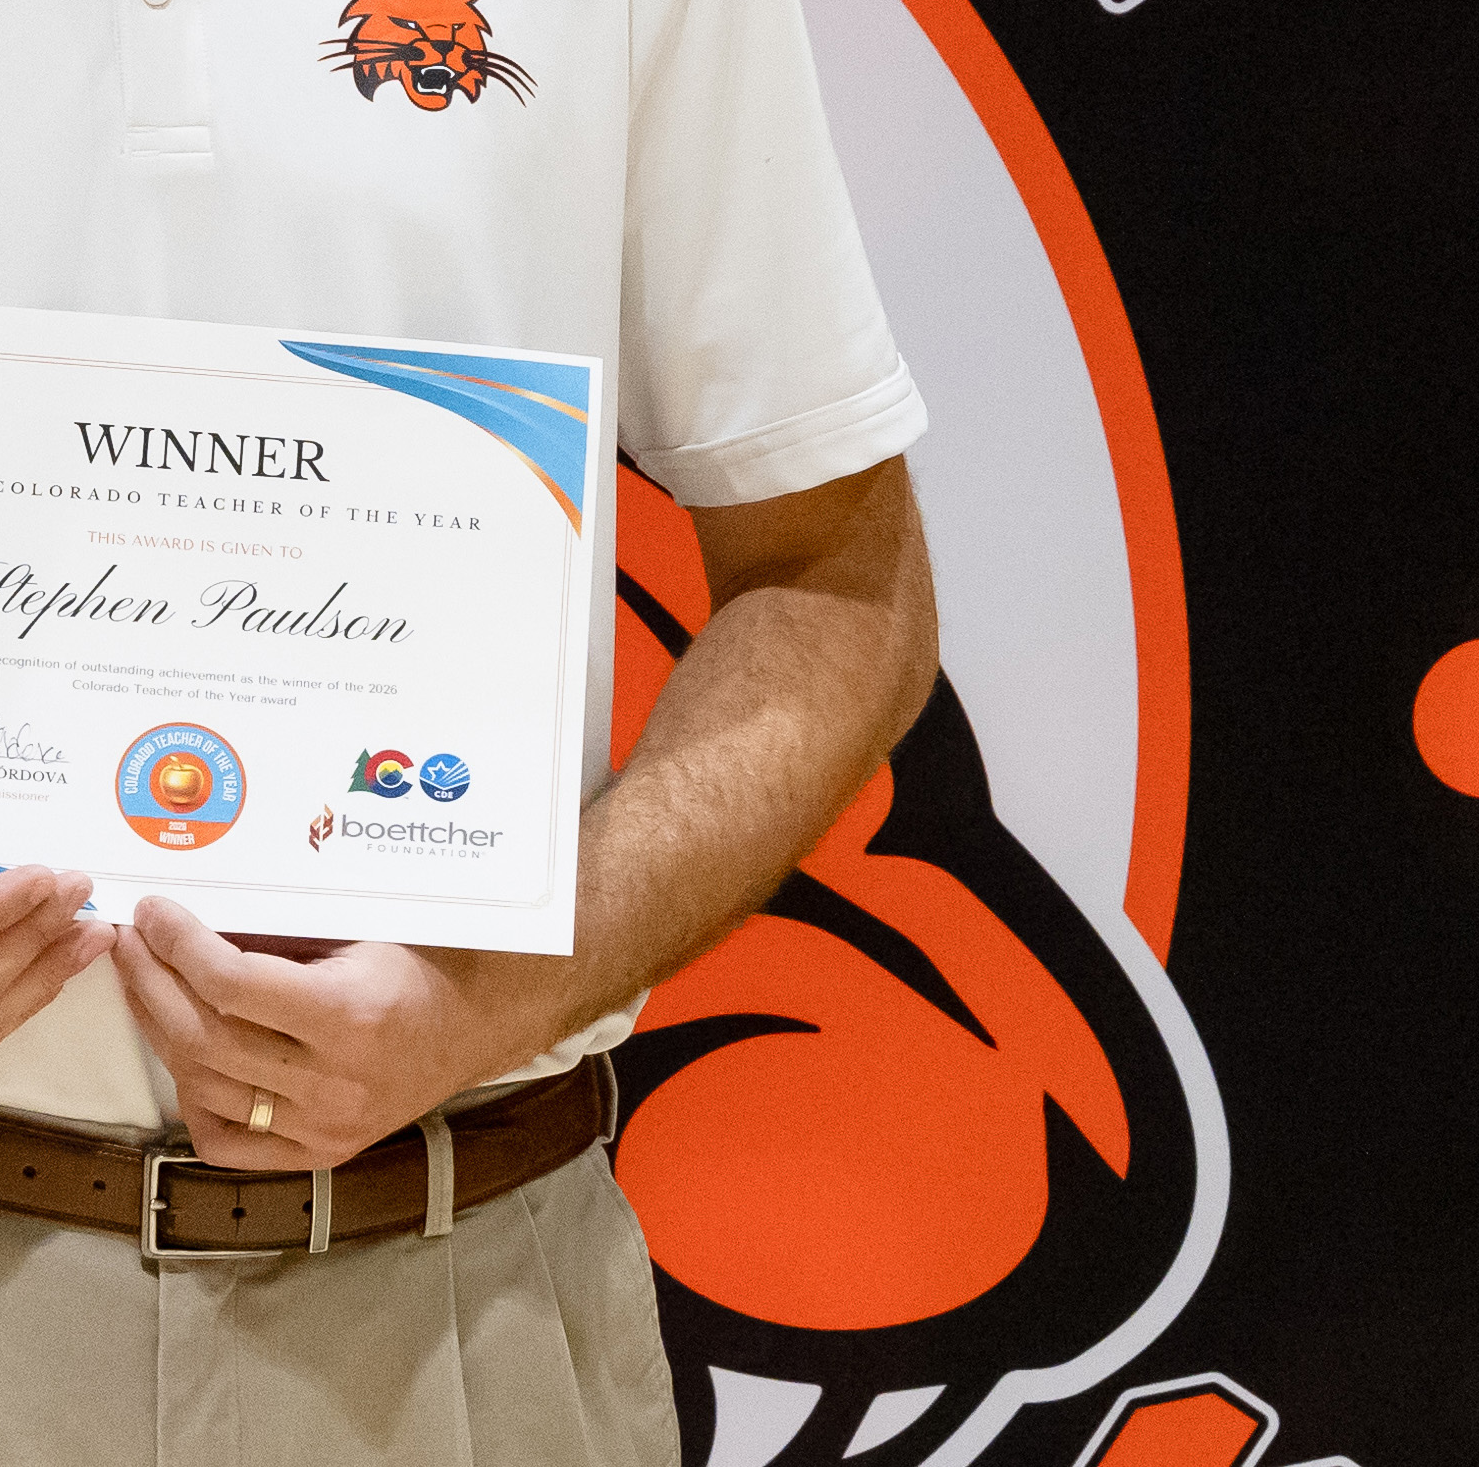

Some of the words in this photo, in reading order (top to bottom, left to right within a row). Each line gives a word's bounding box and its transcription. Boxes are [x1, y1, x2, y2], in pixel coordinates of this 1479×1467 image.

[74, 421, 330, 483] WINNER
[158, 493, 283, 515] TEACHER
[299, 504, 331, 518] OF
[347, 508, 397, 524] THE
[414, 513, 481, 531] YEAR
[88, 531, 126, 545] THIS
[132, 535, 194, 551] AWARD
[201, 539, 215, 552] IS
[221, 541, 273, 557] GIVEN
[279, 545, 303, 559] TO
[191, 579, 414, 644] Paulson
[64, 660, 77, 670] of
[81, 663, 154, 679] outstanding
[158, 668, 236, 682] achievement
[240, 675, 253, 684] as
[258, 675, 277, 686] the
[282, 677, 322, 689] winner
[327, 680, 340, 690] of
[344, 682, 364, 692] the
[368, 683, 398, 695] 2026
[72, 679, 129, 693] Colorado
[133, 683, 182, 698] Teacher
[187, 689, 200, 698] of
[204, 691, 224, 701] the
[229, 692, 256, 703] Year
[260, 695, 297, 706] award
[152, 731, 203, 749] TEACHER
[202, 739, 219, 755] OF
[124, 742, 155, 795] COLORADO
[214, 750, 231, 773] THE
[222, 771, 237, 803] YEAR
[433, 790, 454, 799] CDE
[159, 830, 195, 845] WINNER
[342, 814, 504, 848] boettcher
[367, 843, 481, 859] FOUNDATION
